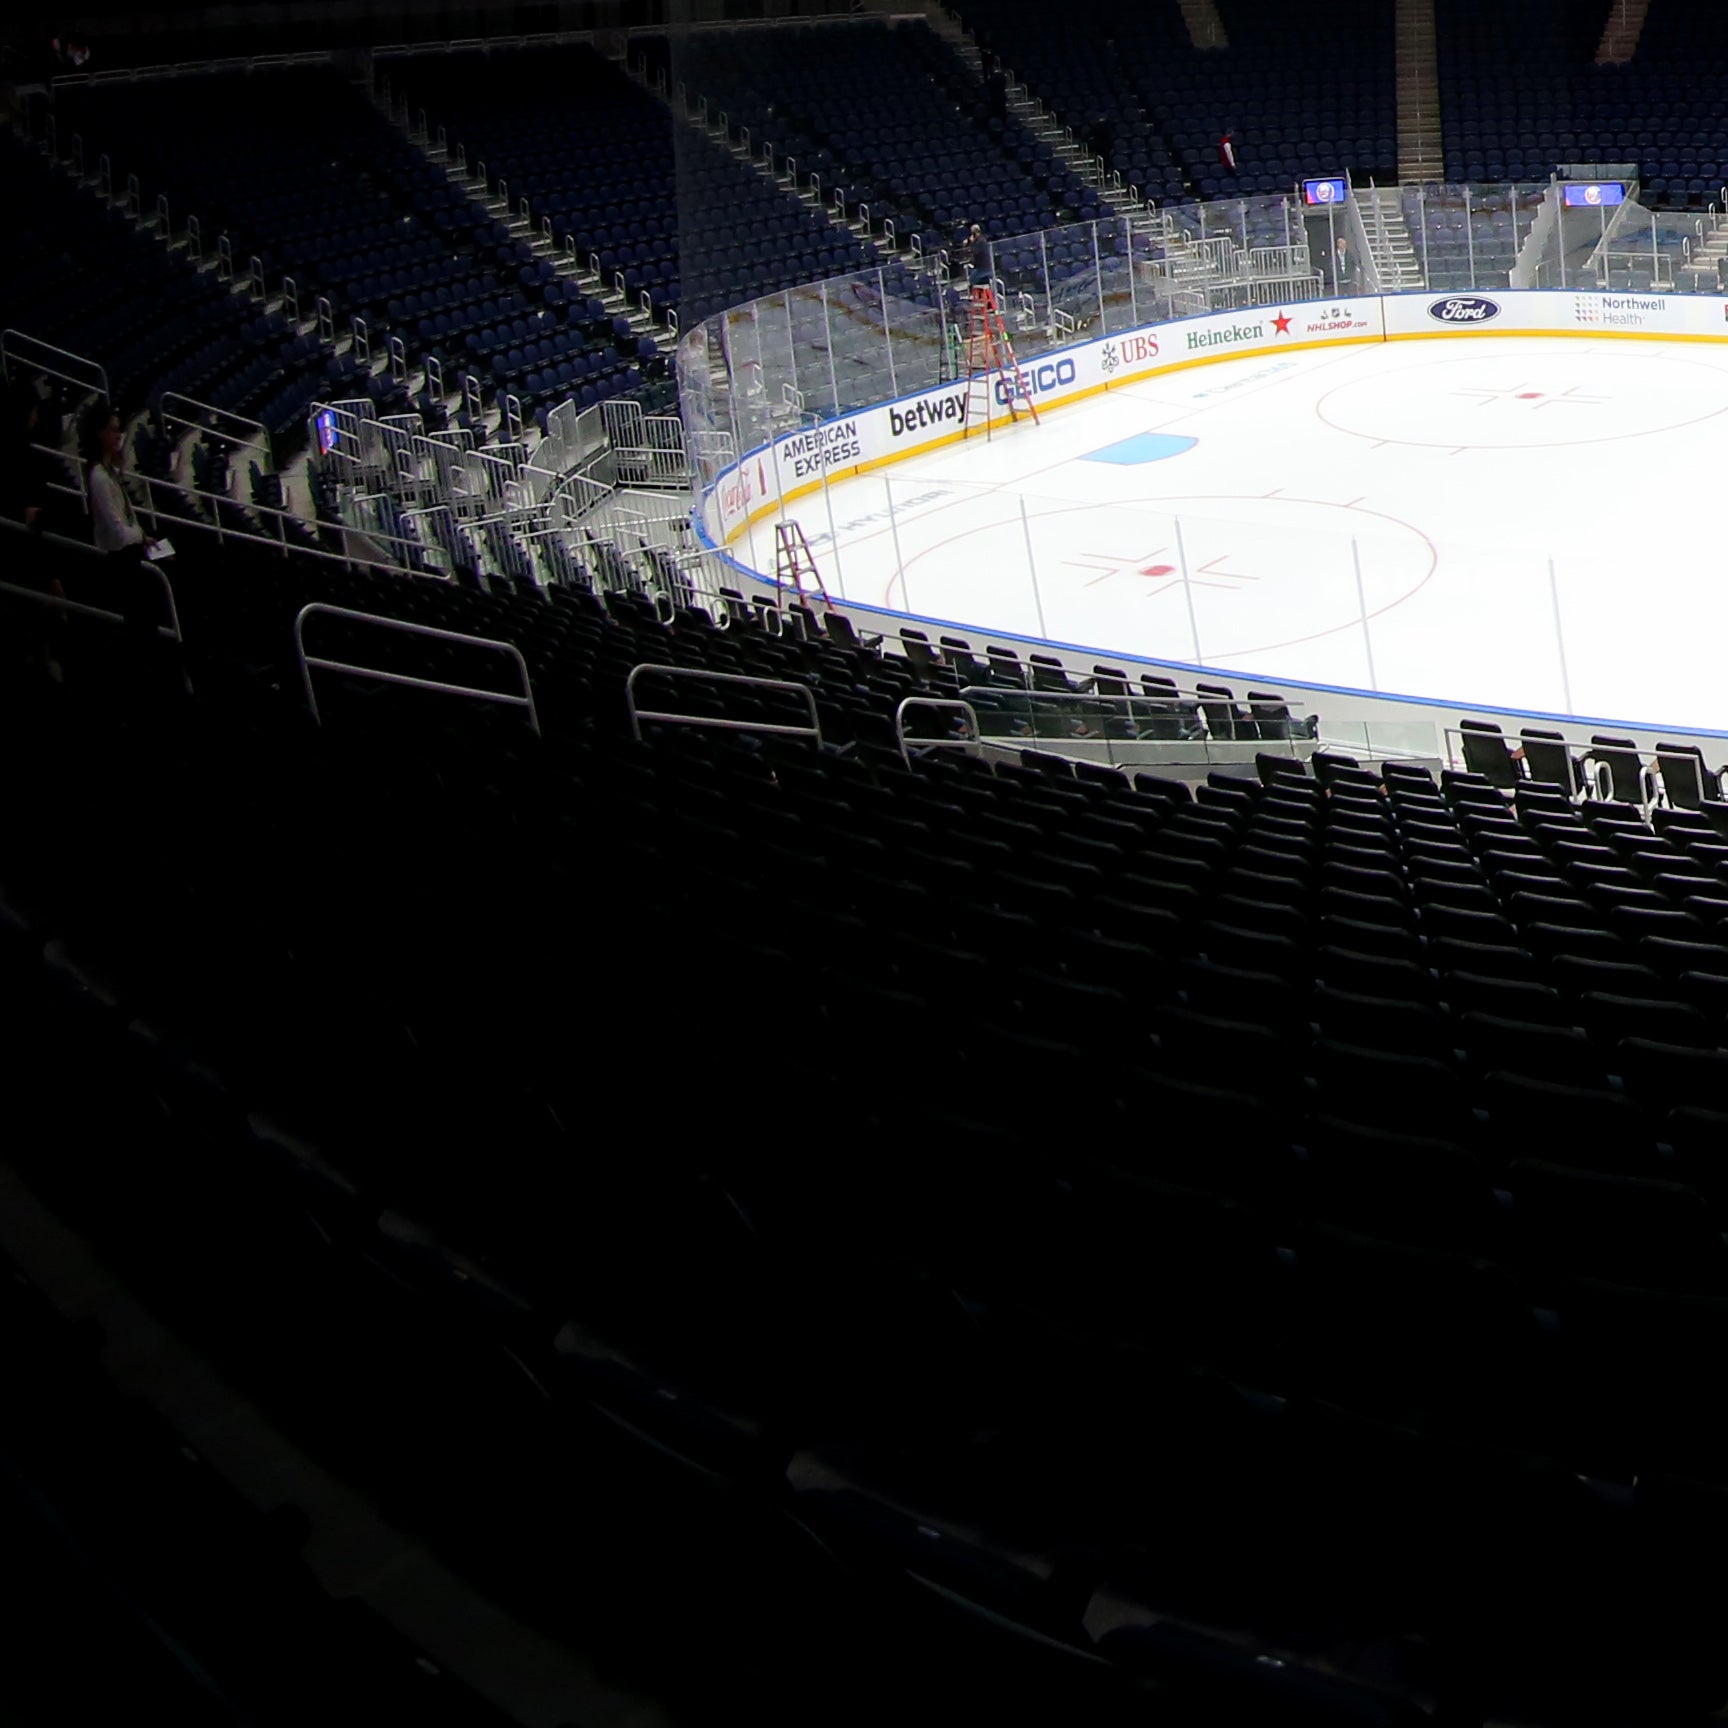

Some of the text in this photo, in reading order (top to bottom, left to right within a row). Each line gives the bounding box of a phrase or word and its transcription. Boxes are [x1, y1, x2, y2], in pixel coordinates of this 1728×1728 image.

[1441, 300, 1488, 321] Ford
[1601, 297, 1666, 312] Northwell
[1602, 312, 1643, 326] Health
[1121, 334, 1159, 365] UBS
[1186, 322, 1263, 350] Heineken
[994, 358, 1076, 406] GEICO
[889, 392, 968, 436] betway
[783, 421, 856, 462] AMERICAN
[794, 441, 861, 478] EXPRESS
